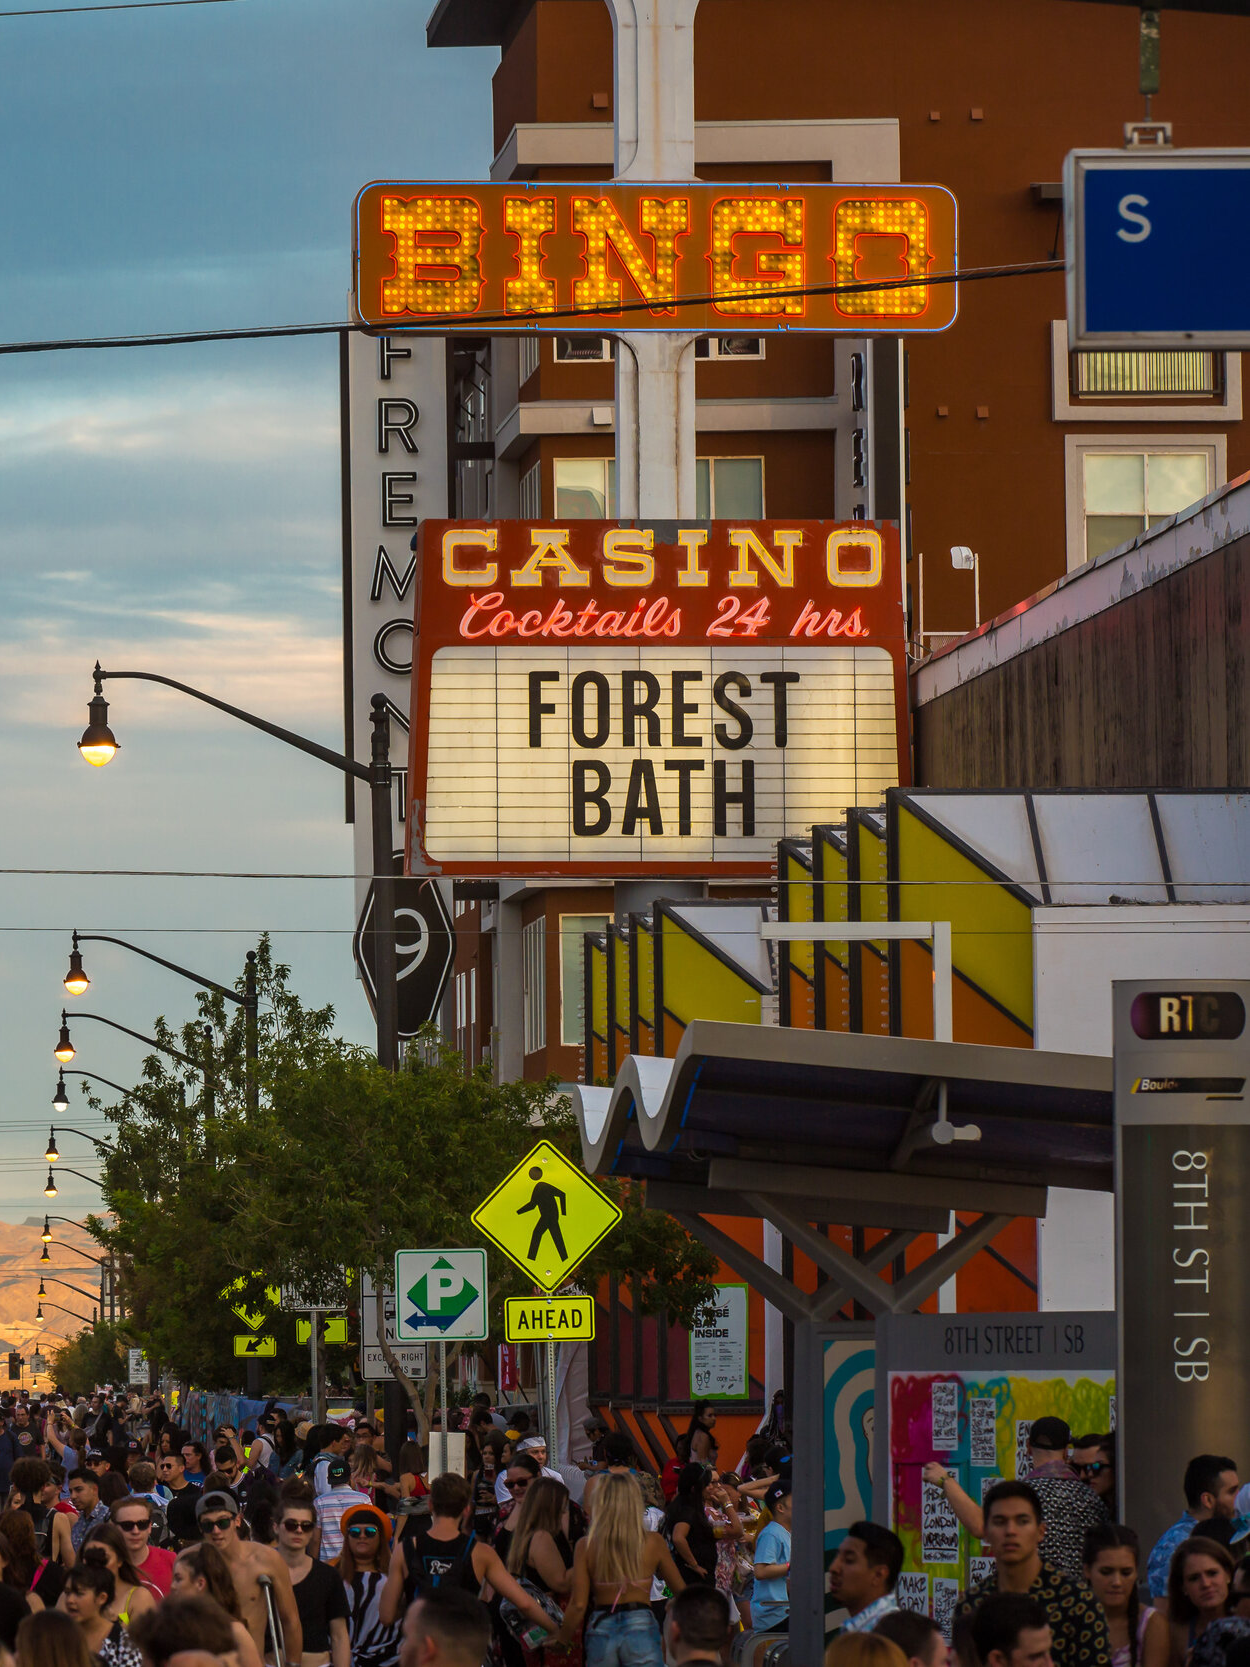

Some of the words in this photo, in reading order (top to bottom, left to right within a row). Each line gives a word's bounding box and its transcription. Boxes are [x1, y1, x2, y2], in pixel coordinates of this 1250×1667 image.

[1116, 194, 1152, 243] S
[380, 196, 934, 317] BINGO
[441, 528, 884, 588] CASINO
[458, 590, 682, 640] Cocktails
[705, 595, 773, 639] 24
[527, 670, 801, 749] FOREST
[571, 759, 756, 838] BATH
[1172, 1150, 1209, 1230] 8TH
[427, 1268, 464, 1311] P
[1172, 1248, 1210, 1294] ST
[516, 1308, 584, 1332] AHEAD
[694, 1328, 729, 1339] INSIDE
[944, 1325, 978, 1355] 8TH
[984, 1325, 1044, 1355] STREET
[1063, 1324, 1085, 1354] SB
[401, 1352, 424, 1362] RIGHT
[1173, 1336, 1211, 1383] SB
[923, 1516, 957, 1530] LONDON
[898, 1575, 927, 1594] MAKE
